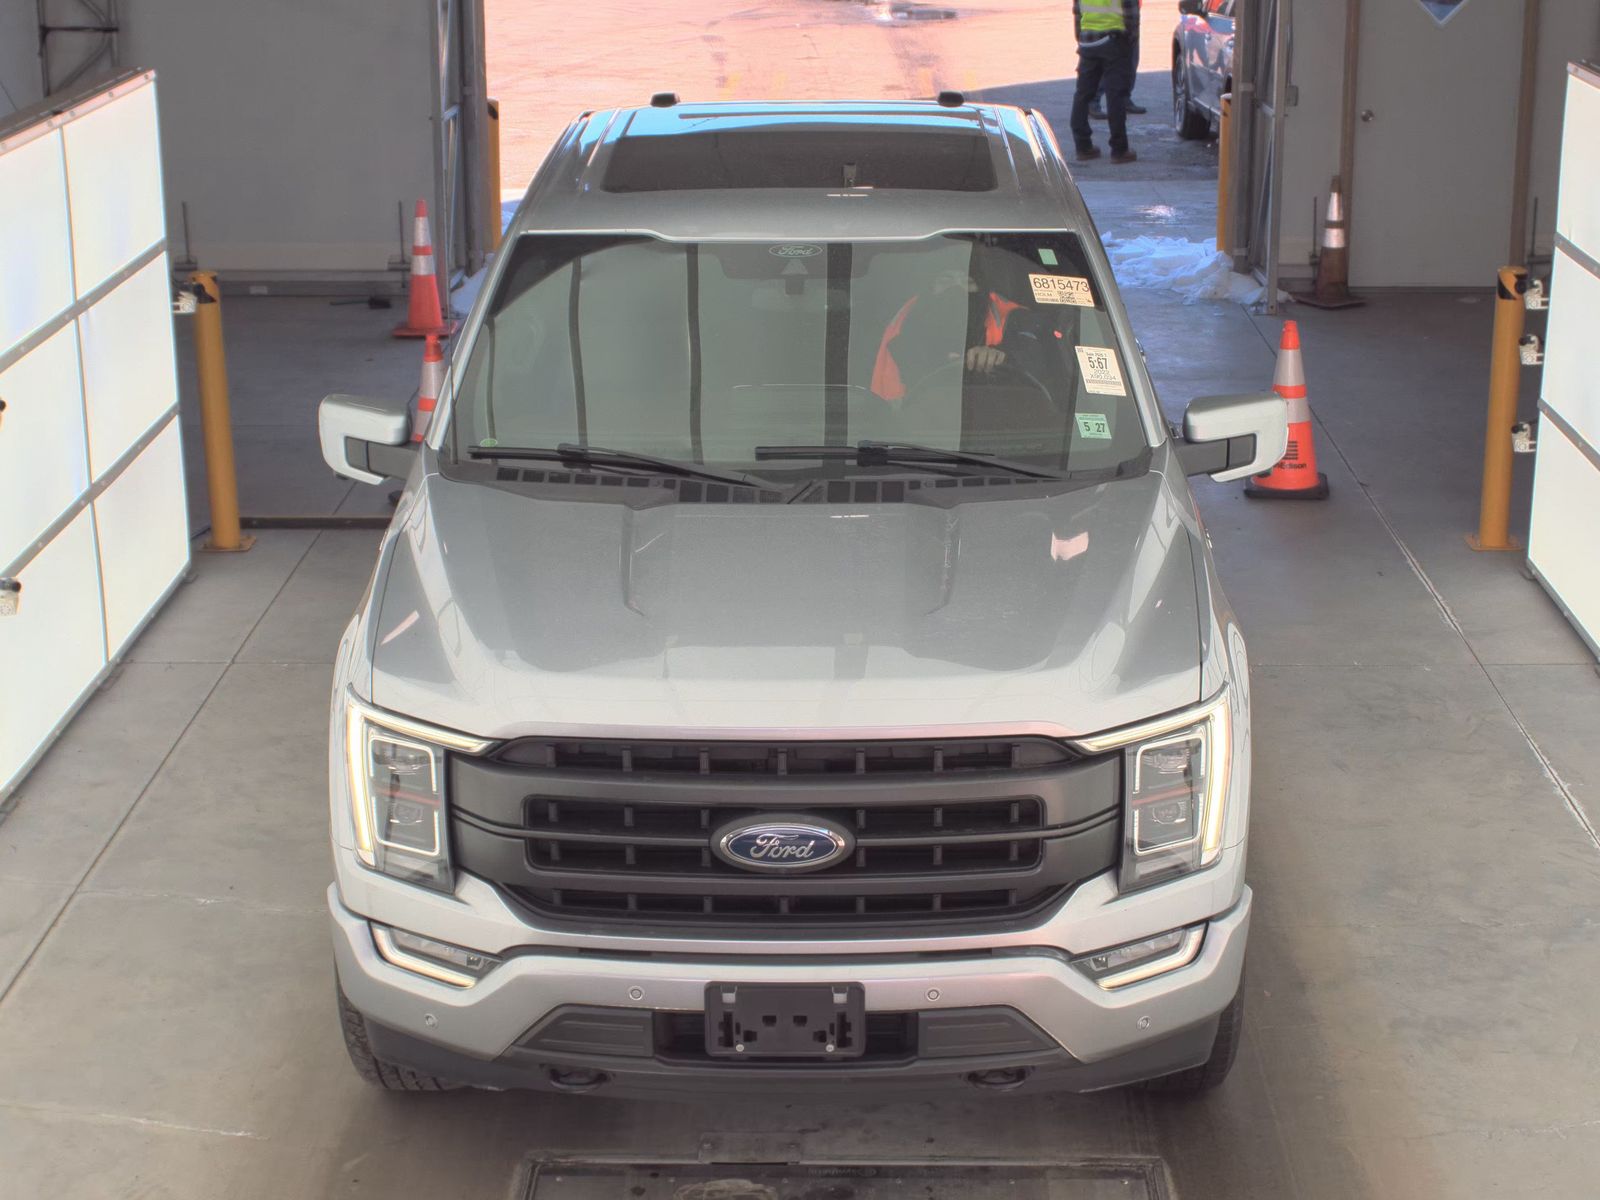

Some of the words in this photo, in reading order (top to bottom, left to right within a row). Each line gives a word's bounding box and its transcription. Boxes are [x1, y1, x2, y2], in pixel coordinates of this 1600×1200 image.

[778, 245, 813, 255] Ford
[1033, 277, 1090, 292] 6815473
[1088, 356, 1108, 369] 5:67
[1083, 421, 1091, 432] 5
[1095, 422, 1105, 433] 27
[750, 833, 815, 858] Ford
